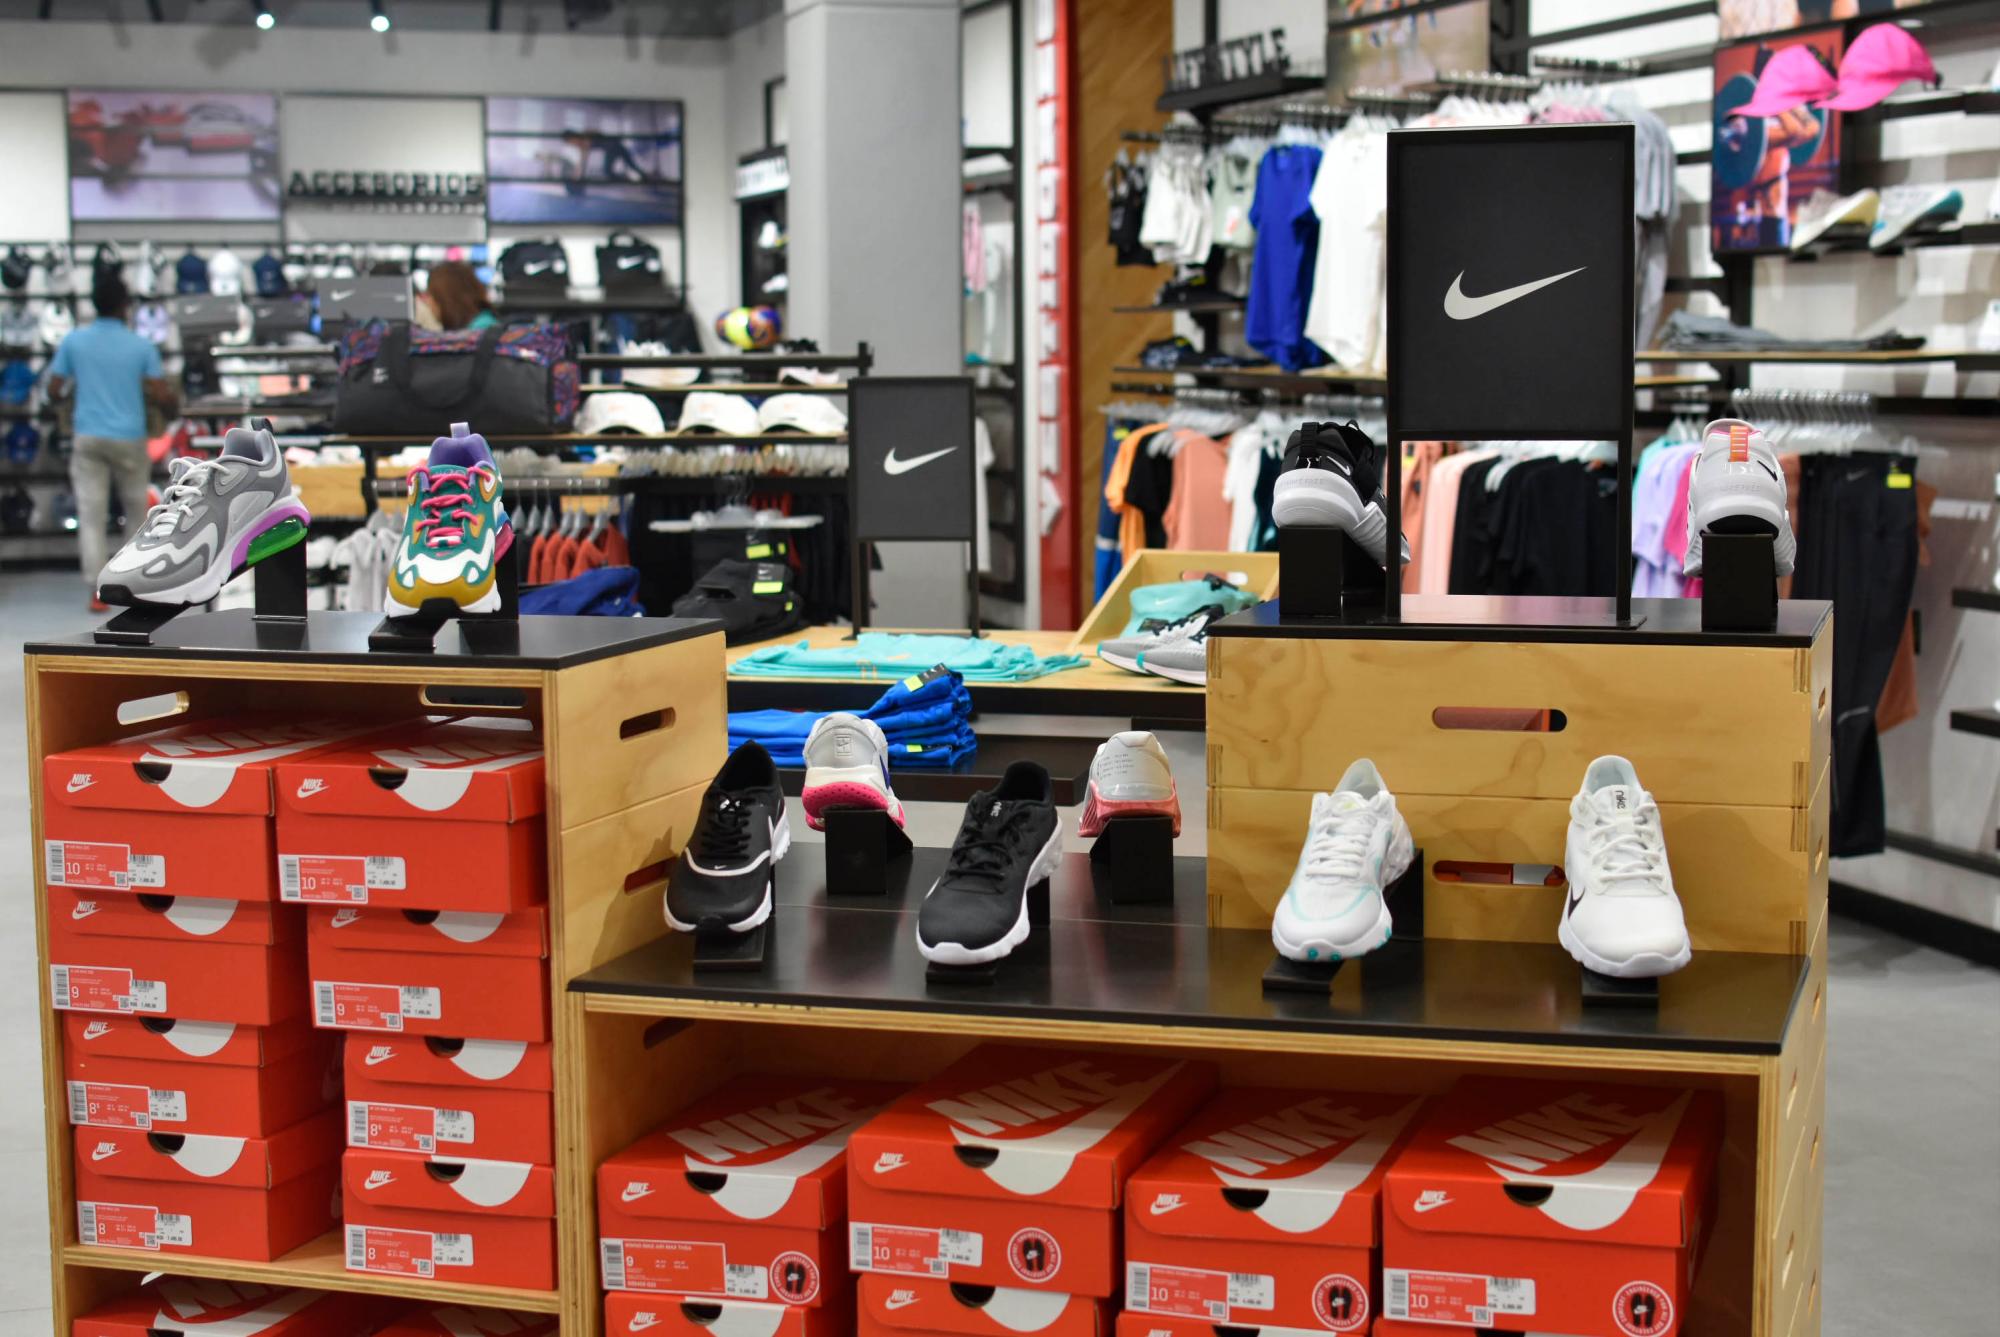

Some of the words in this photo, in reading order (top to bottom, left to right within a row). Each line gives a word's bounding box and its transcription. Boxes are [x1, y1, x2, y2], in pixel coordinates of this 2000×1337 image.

[71, 773, 92, 785] NIKE
[301, 778, 324, 790] NIKE
[66, 862, 81, 875] 10
[301, 877, 316, 890] 10
[75, 901, 97, 913] NIKE
[71, 986, 79, 998] 9
[337, 1003, 345, 1016] 9
[87, 1021, 109, 1033] NIKE
[369, 1046, 392, 1058] NIKE
[924, 1062, 1116, 1135] NIKE
[665, 1086, 857, 1163] NIKE
[1180, 1097, 1362, 1176] NIKE
[1445, 1092, 1640, 1173] NIKE
[95, 1142, 116, 1154] NIKE
[880, 1153, 904, 1165] NIKE
[369, 1170, 392, 1182] NIKE
[627, 1182, 650, 1194] NIKE
[1157, 1193, 1181, 1205] NIKE
[1421, 1190, 1447, 1202] NIKE
[98, 1223, 106, 1235] 8
[368, 1247, 376, 1260] 8
[873, 1246, 890, 1260] 10
[625, 1256, 634, 1267] 9
[890, 1290, 916, 1302] NIKE
[1151, 1287, 1168, 1301] 10
[1410, 1293, 1429, 1308] 10
[634, 1311, 657, 1323] NIKE
